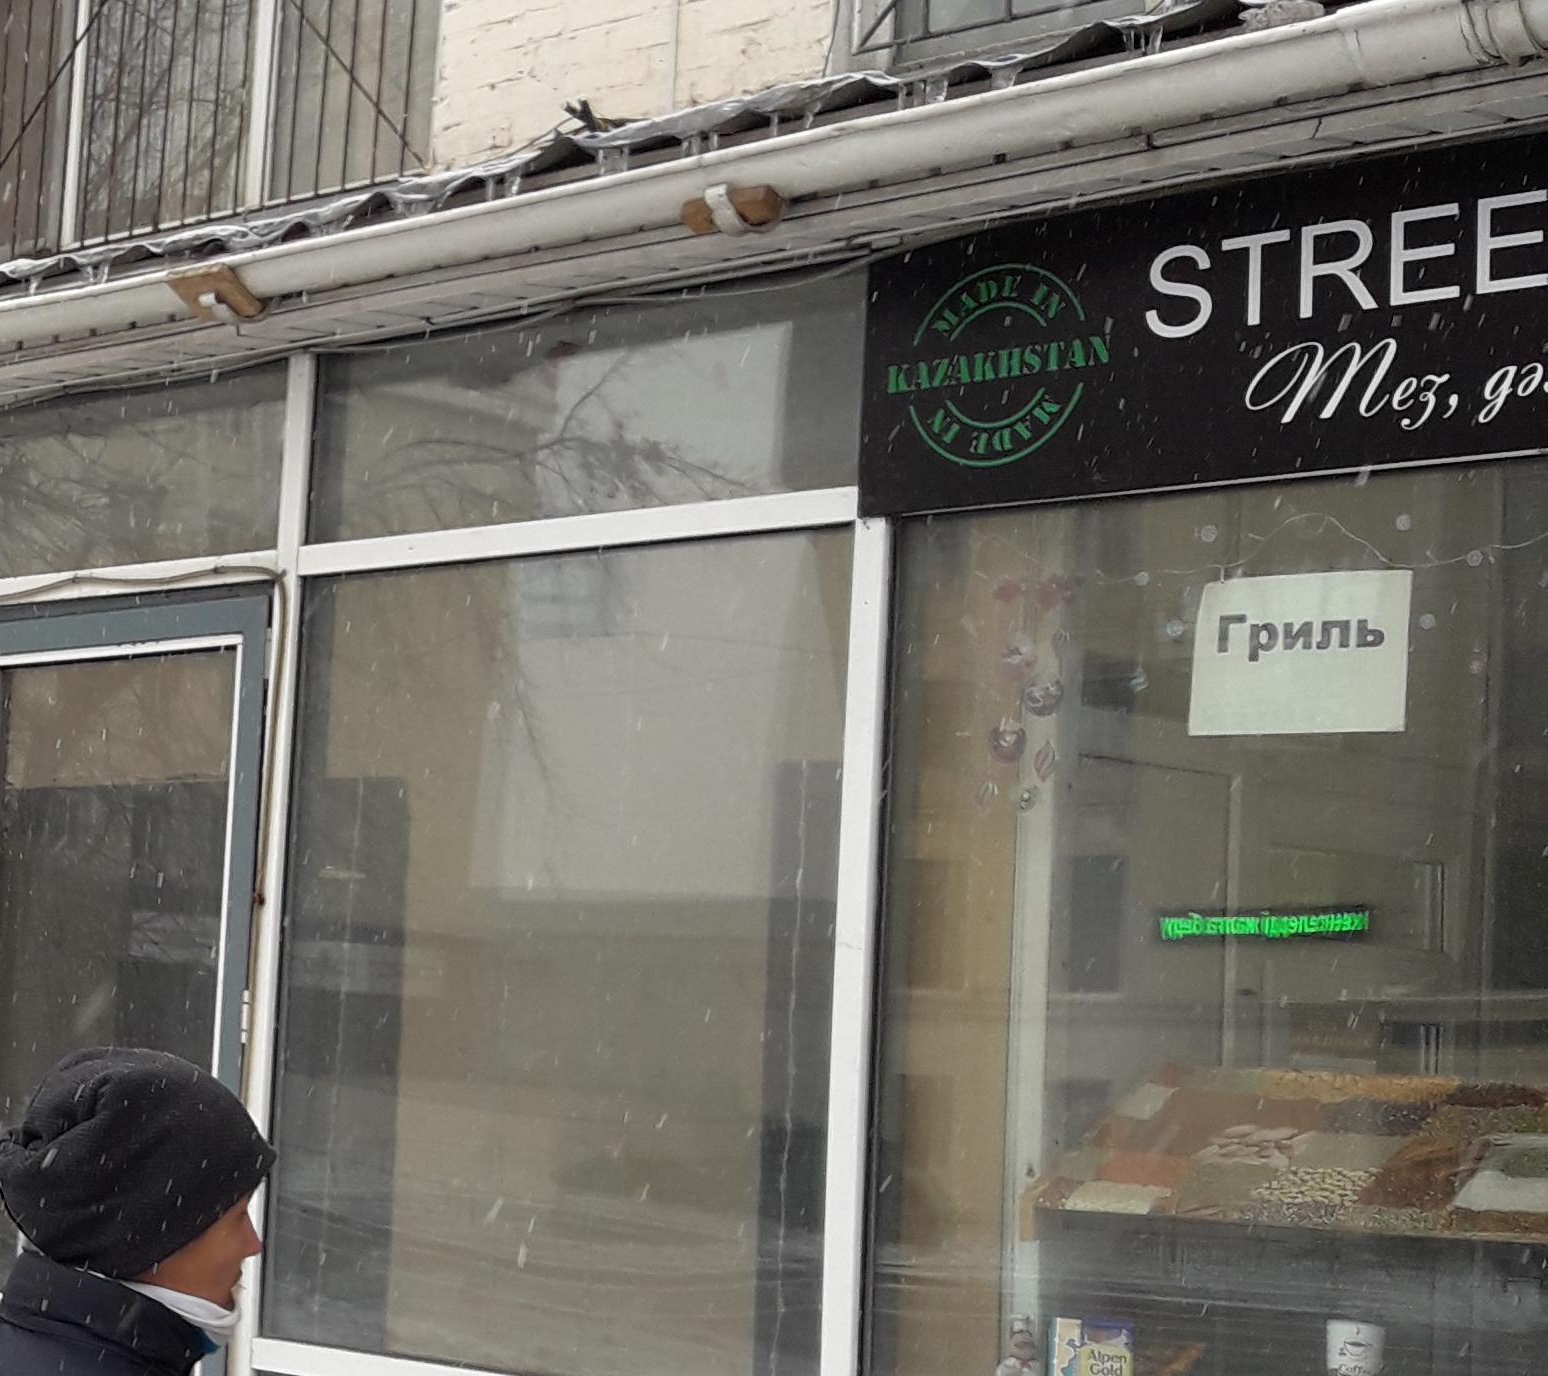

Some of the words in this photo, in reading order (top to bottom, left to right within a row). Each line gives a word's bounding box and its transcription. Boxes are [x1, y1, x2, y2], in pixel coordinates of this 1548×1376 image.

[931, 275, 1021, 337] MADE
[1030, 282, 1067, 318] IN
[886, 334, 1111, 394] KAZAKHSTAN
[969, 394, 1061, 454] MADE
[1217, 613, 1385, 663] Гриль
[1088, 1348, 1127, 1364] Alpen
[1090, 1364, 1122, 1376] Gold
